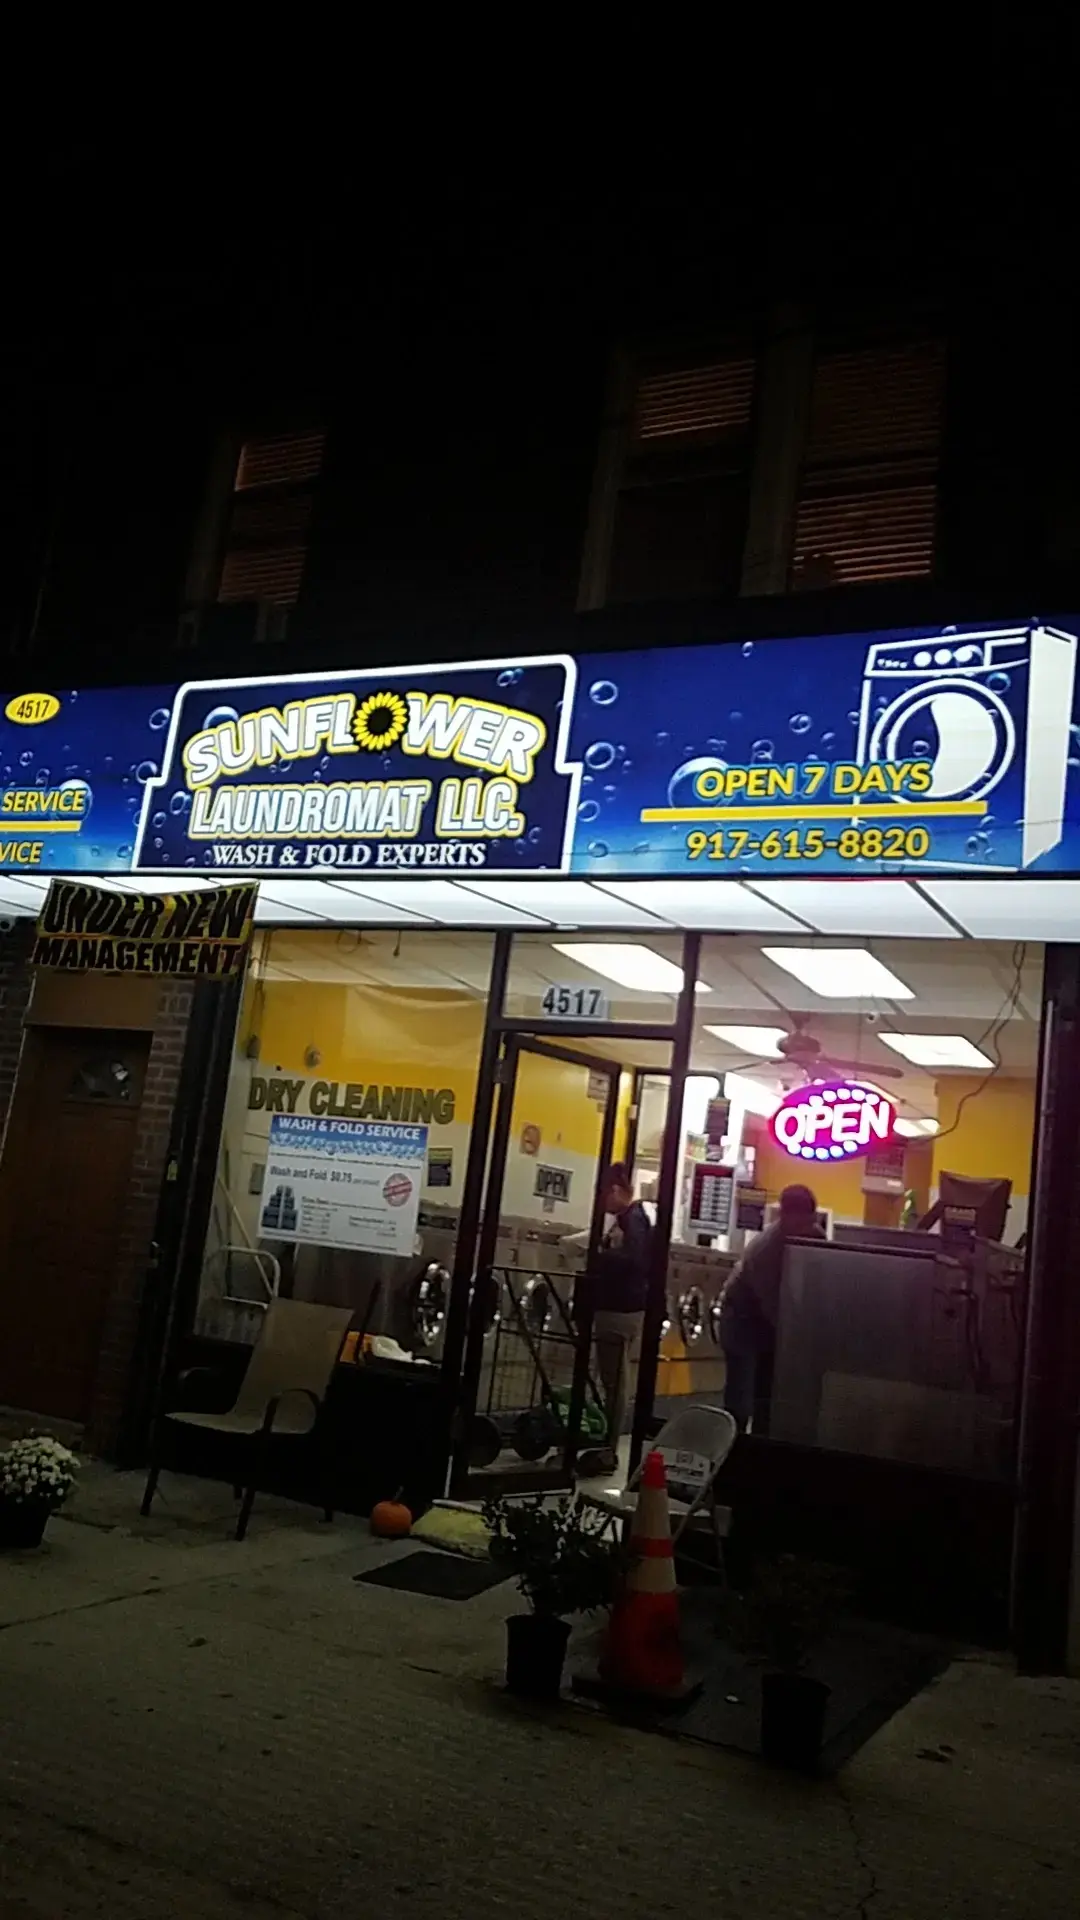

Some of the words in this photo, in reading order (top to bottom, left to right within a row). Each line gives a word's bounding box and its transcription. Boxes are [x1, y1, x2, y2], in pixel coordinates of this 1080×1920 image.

[16, 699, 50, 719] 4517
[185, 689, 547, 789] SUNFLOWER
[696, 766, 797, 798] OPEN
[803, 766, 826, 795] 7
[834, 761, 933, 793] DAYS
[1, 789, 87, 812] SERVICE
[190, 781, 430, 838] LAUNDROMAT
[436, 776, 525, 837] LLC.
[213, 844, 273, 866] WASH
[280, 846, 301, 866] &
[304, 844, 371, 866] FOLD
[377, 841, 486, 866] EXPERTS
[686, 827, 930, 859] 917-615-8820
[43, 880, 164, 938] UNDER
[163, 885, 253, 938] NEW
[33, 938, 243, 975] MANAGEMENT
[542, 987, 602, 1015] 4517
[248, 1076, 306, 1113] DRY
[309, 1080, 456, 1125] CLEANING
[278, 1116, 317, 1132] WASH
[318, 1120, 328, 1132] &
[329, 1120, 362, 1136] FOLD
[365, 1123, 421, 1141] SERVICE
[773, 1101, 892, 1147] OPEN
[270, 1165, 291, 1177] Wash
[292, 1167, 308, 1179] and
[537, 1166, 571, 1198] OPEN
